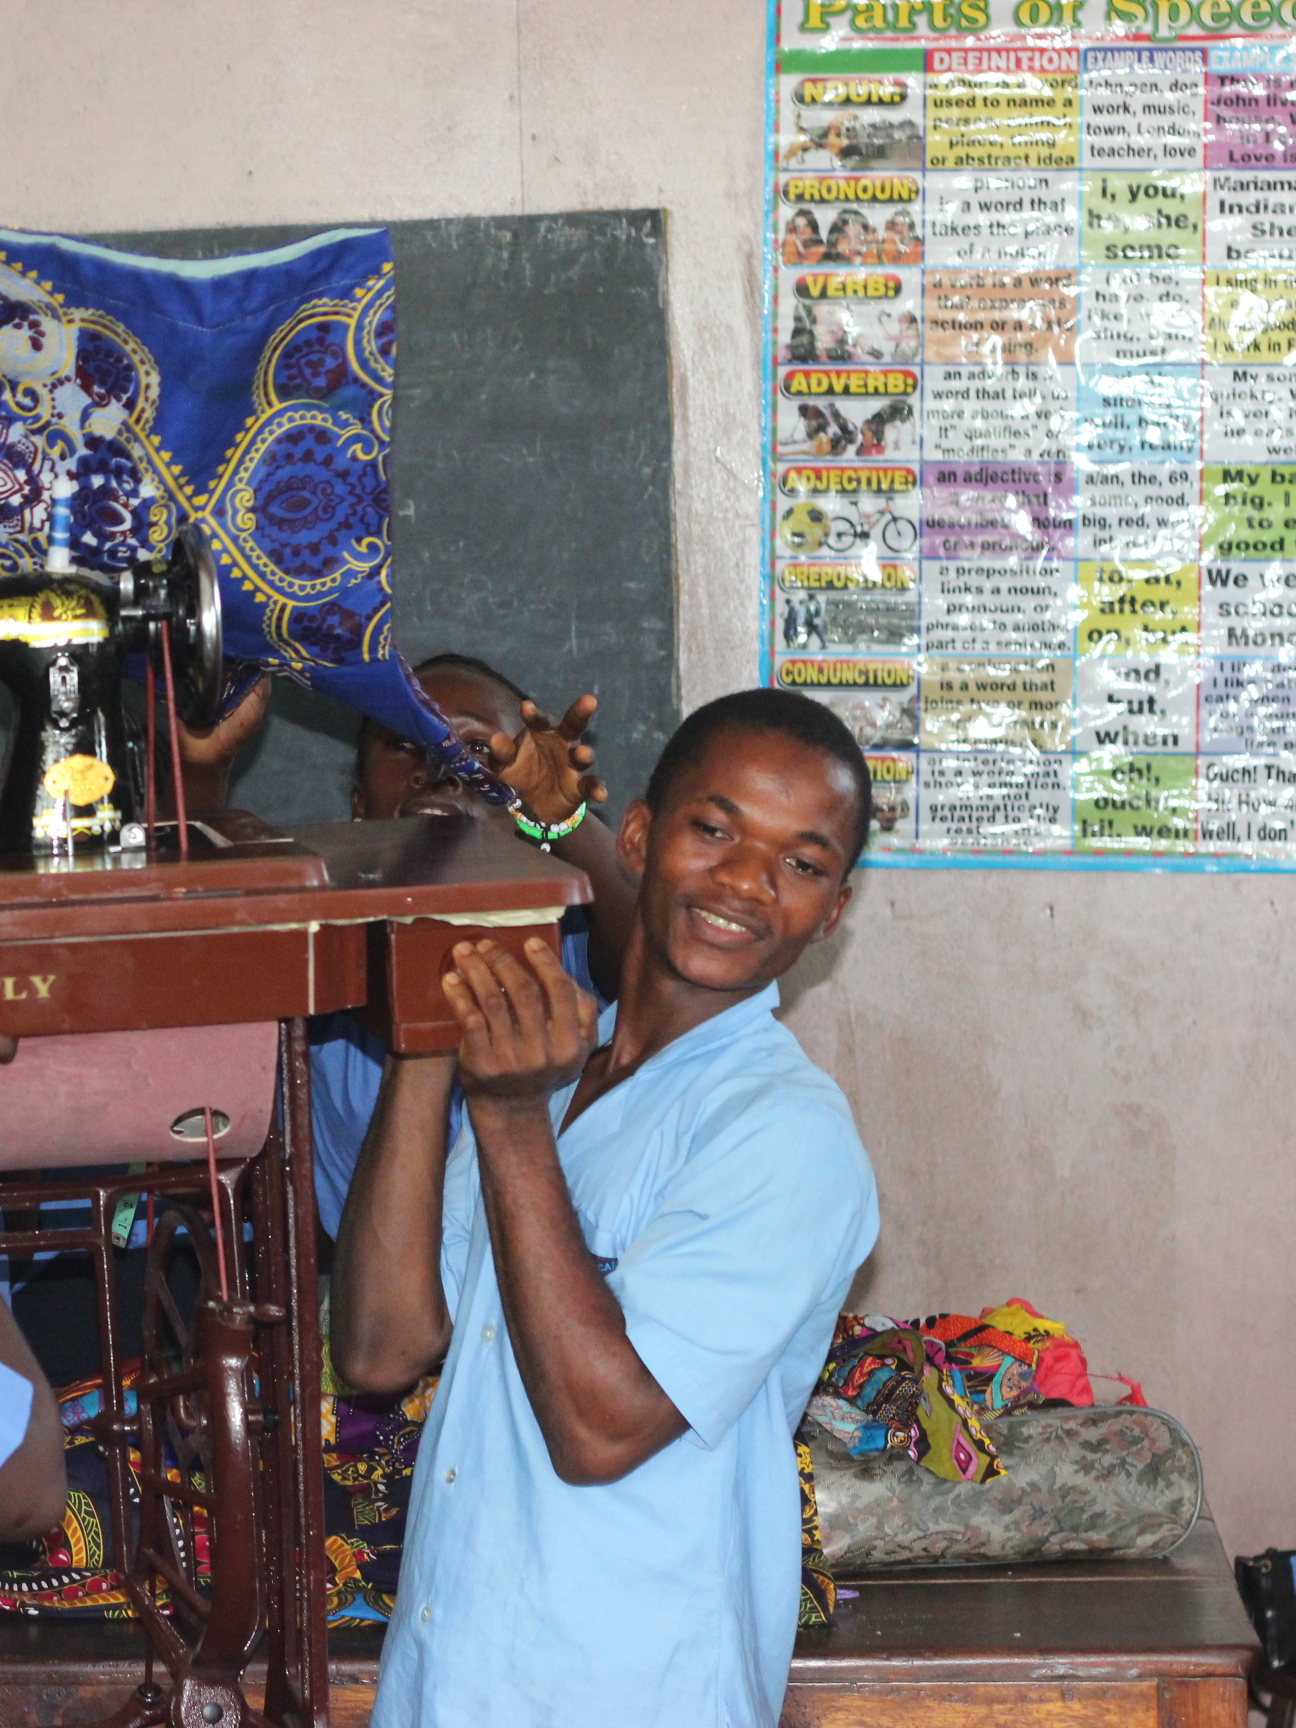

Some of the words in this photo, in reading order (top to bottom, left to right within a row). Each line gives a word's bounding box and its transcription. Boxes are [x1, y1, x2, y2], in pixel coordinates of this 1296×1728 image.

[799, 0, 991, 33] Parts
[1014, 0, 1082, 28] of
[933, 50, 1079, 72] DEFINITION
[1086, 50, 1150, 70] EXAMPLE
[1154, 50, 1204, 70] WORDS
[1039, 74, 1078, 88] ord
[933, 96, 975, 108] used
[983, 98, 1000, 108] to
[1007, 98, 1056, 108] name
[1063, 98, 1072, 108] a
[1211, 94, 1259, 107] John
[1092, 101, 1136, 117] work,
[1143, 101, 1195, 116] music,
[1087, 122, 1130, 136] town,
[930, 156, 948, 166] or
[954, 153, 1030, 166] abstract
[1037, 153, 1075, 166] idea
[1091, 144, 1157, 160] teacher,
[1164, 144, 1197, 158] love
[1229, 150, 1275, 163] Love
[788, 179, 916, 200] PRONOUN:
[1128, 184, 1185, 203] you,
[962, 200, 971, 212] a
[979, 197, 1023, 212] word
[1030, 197, 1067, 212] that
[932, 221, 982, 236] takes
[806, 275, 896, 297] VERB:
[1013, 276, 1022, 288] a
[1029, 273, 1072, 288] word
[930, 319, 984, 331] action
[990, 321, 1008, 331] or
[1013, 321, 1023, 331] a
[1268, 337, 1281, 352] in
[790, 371, 914, 393] ADVERB:
[944, 370, 962, 381] an
[1026, 368, 1038, 381] is
[1233, 370, 1258, 383] My
[932, 388, 970, 400] word
[976, 388, 1006, 400] that
[926, 409, 965, 420] more
[785, 469, 914, 490] ADJECTIVE:
[937, 470, 957, 484] an
[963, 467, 1041, 486] adjective
[1085, 471, 1124, 487] a/an,
[1131, 471, 1162, 487] the,
[1223, 469, 1260, 487] My
[1225, 491, 1273, 511] big.
[1285, 491, 1290, 507] I
[1032, 517, 1072, 529] noun
[1082, 513, 1112, 530] big,
[1118, 513, 1150, 529] red,
[1247, 516, 1273, 529] to
[1219, 536, 1284, 556] good
[784, 565, 915, 588] PREPOSION:
[939, 566, 948, 576] a
[1207, 568, 1248, 588] We
[941, 582, 984, 594] links
[991, 586, 1001, 595] a
[1008, 584, 1057, 597] noun,
[946, 603, 1026, 615] pronoun,
[1034, 604, 1050, 614] or
[926, 638, 956, 652] part
[962, 637, 976, 650] of
[781, 662, 914, 684] CONJUNCTION:
[940, 679, 953, 691] is
[960, 681, 969, 691] a
[976, 679, 1016, 691] word
[1023, 679, 1055, 691] that
[924, 696, 963, 712] joins
[1029, 700, 1067, 710] mor
[1095, 724, 1179, 746] when
[954, 769, 963, 777] a
[1206, 762, 1257, 783] Ouch!
[929, 803, 1060, 814] grammatically
[931, 814, 996, 823] related
[1005, 814, 1021, 823] to
[1248, 822, 1251, 840] I
